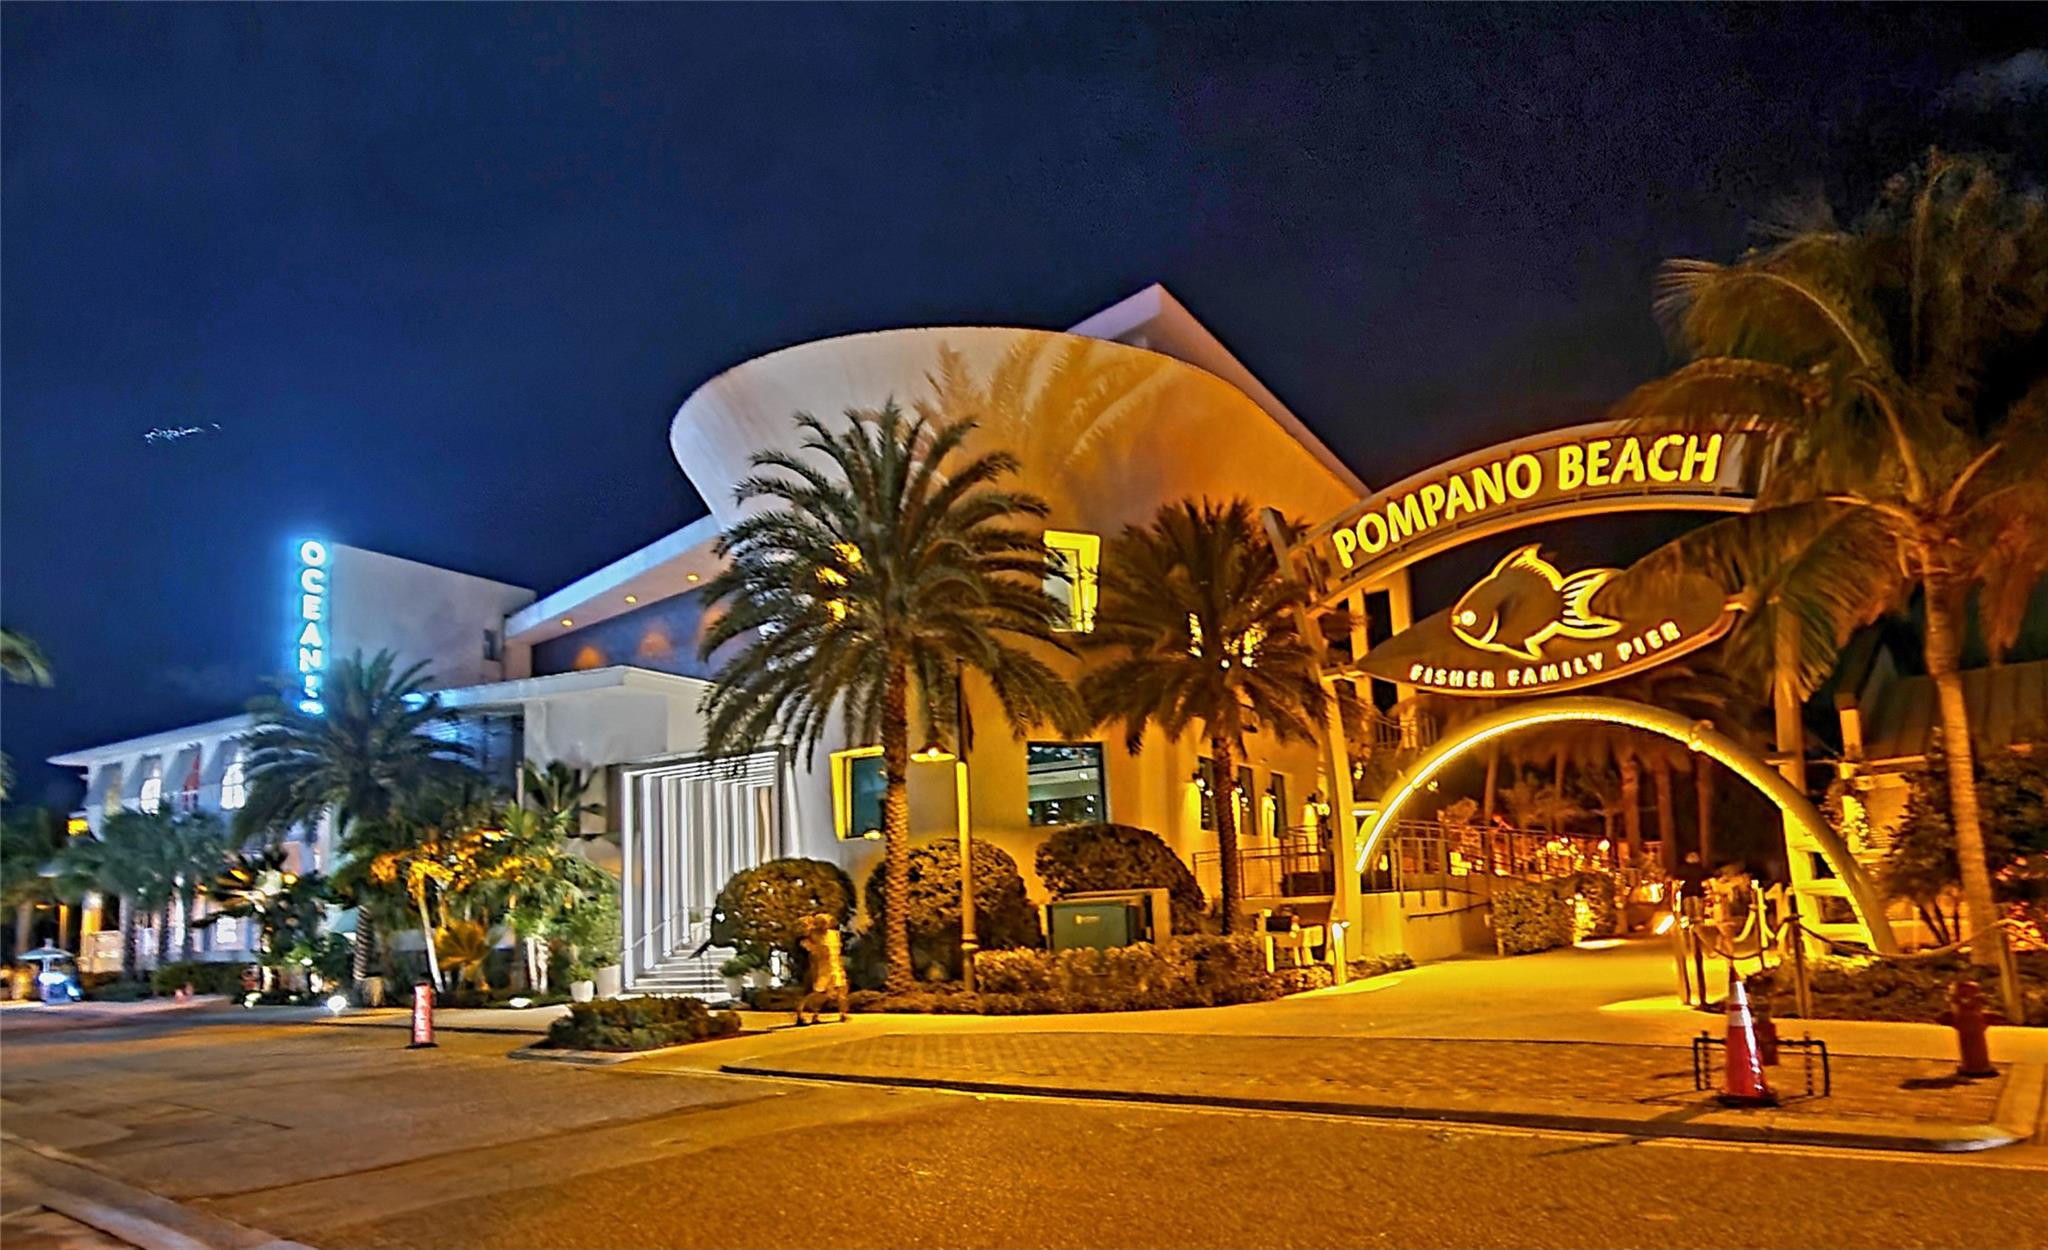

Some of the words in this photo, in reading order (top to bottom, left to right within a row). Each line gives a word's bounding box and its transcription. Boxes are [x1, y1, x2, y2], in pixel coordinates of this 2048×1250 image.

[1332, 453, 1542, 568] POMPANO
[1558, 434, 1723, 491] BEACH
[1409, 664, 1496, 688] FISHER
[1507, 652, 1604, 687] FAMILY
[1616, 621, 1681, 662] PIER
